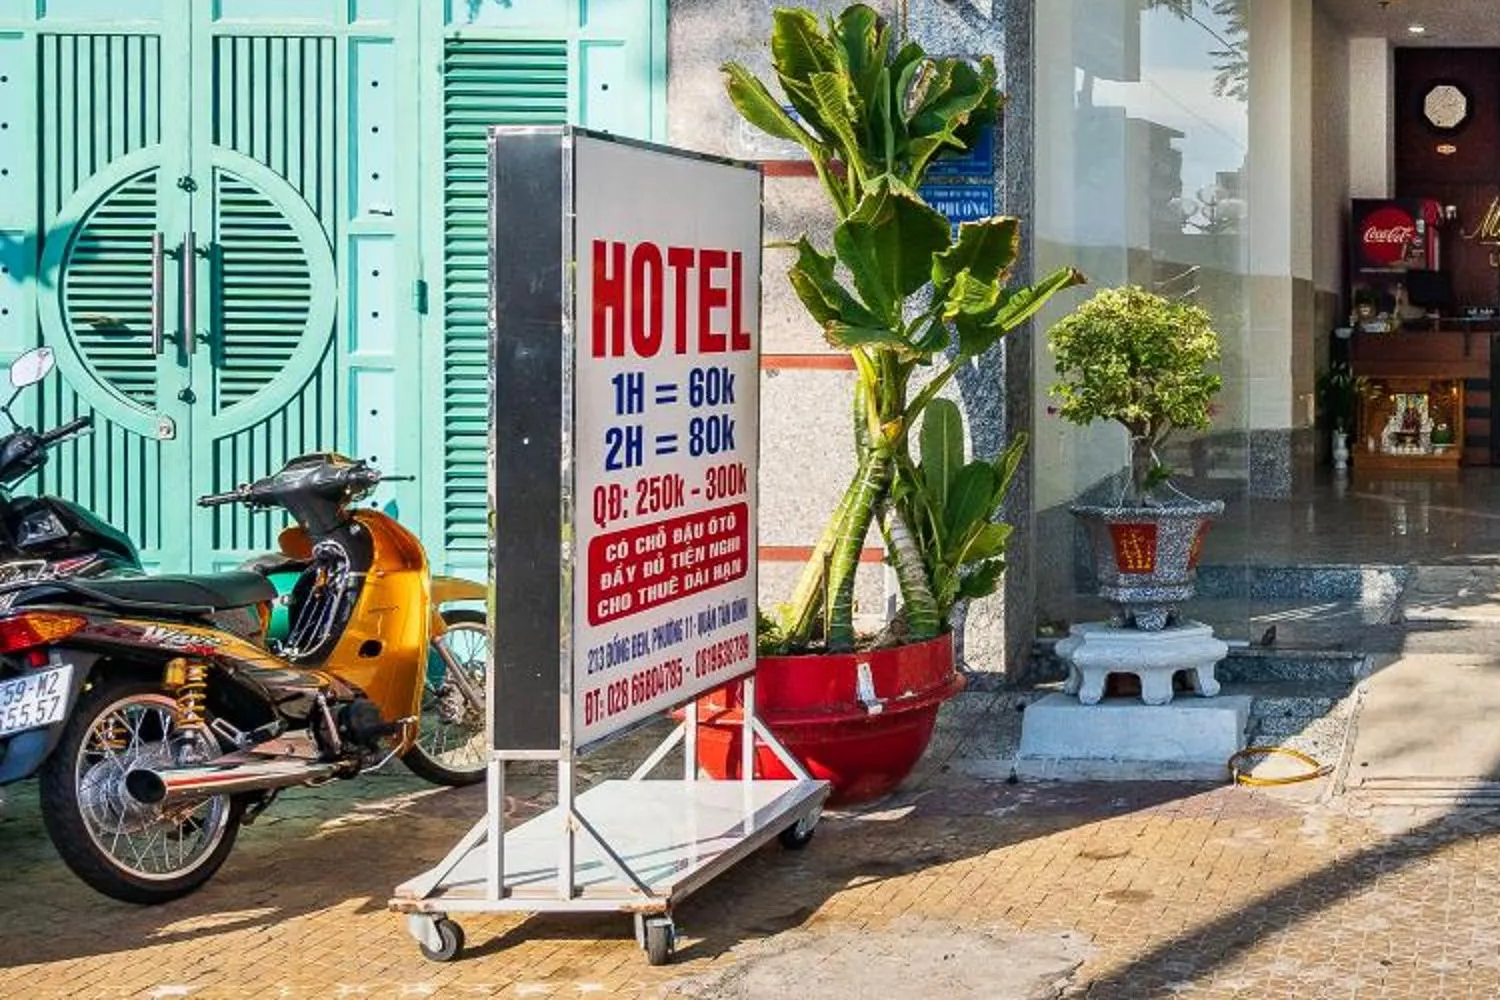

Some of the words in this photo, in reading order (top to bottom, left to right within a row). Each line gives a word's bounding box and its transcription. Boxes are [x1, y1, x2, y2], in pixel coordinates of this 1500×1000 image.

[592, 240, 751, 358] HOTEL
[612, 371, 645, 415] 1H
[656, 384, 678, 404] =
[689, 366, 735, 408] 60k
[605, 424, 643, 472] 2H
[656, 434, 678, 455] =
[689, 413, 735, 457] 80k
[593, 484, 629, 528] QĐ:
[636, 473, 685, 516] 250k
[705, 462, 747, 501] 300k
[605, 537, 629, 563] CÓ
[672, 520, 704, 546] ĐẬU
[671, 544, 705, 570] TIỆN
[709, 535, 741, 559] NGHI
[597, 593, 633, 618] CHO
[638, 575, 679, 605] THUÊ
[713, 556, 742, 583] HẠN
[587, 645, 605, 675] 213
[685, 615, 693, 639] 11
[585, 688, 605, 727] ĐT:
[607, 677, 629, 716] 028
